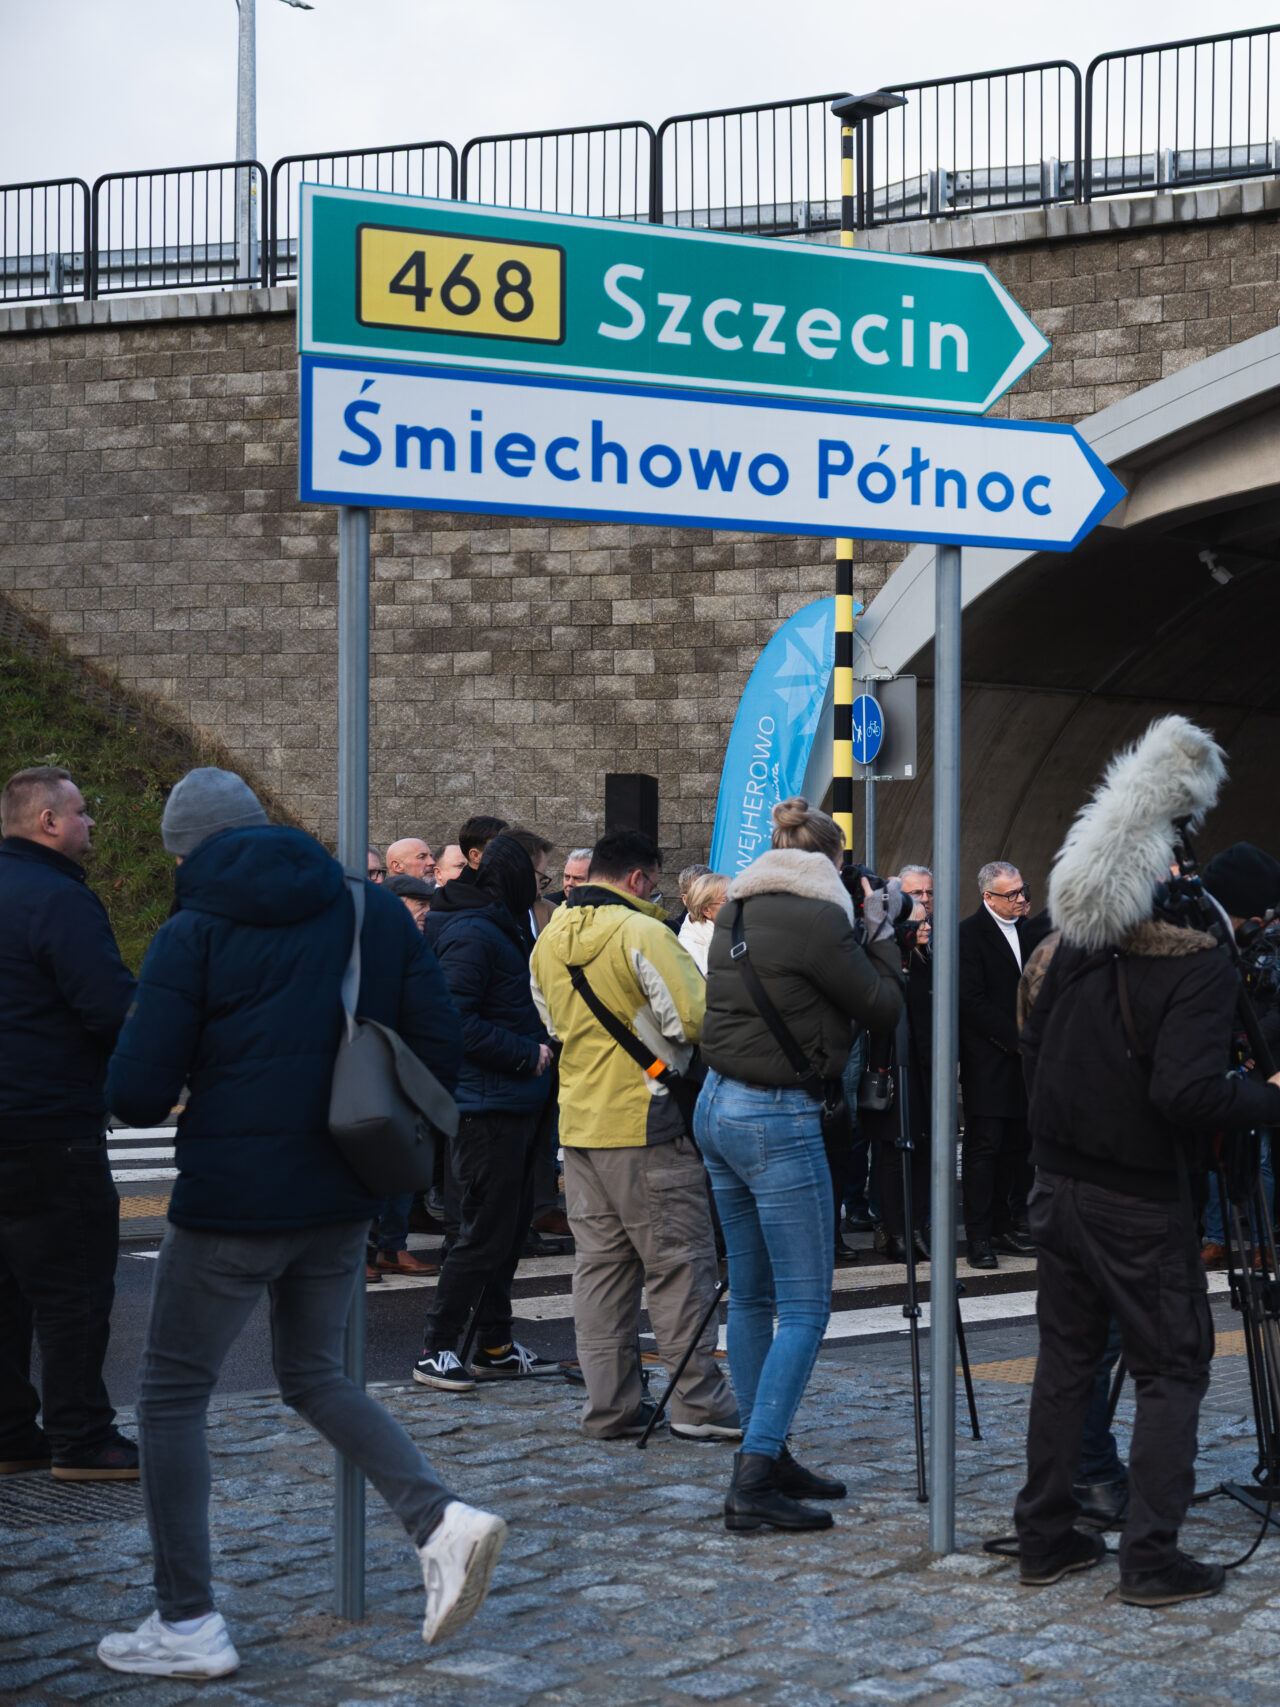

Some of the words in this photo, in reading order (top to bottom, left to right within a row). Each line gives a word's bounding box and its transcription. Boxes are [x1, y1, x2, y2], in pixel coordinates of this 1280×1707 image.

[389, 251, 534, 322] 468
[599, 264, 968, 372] Szczecin
[338, 379, 789, 496] Śmiechowo
[818, 439, 1051, 515] Północ
